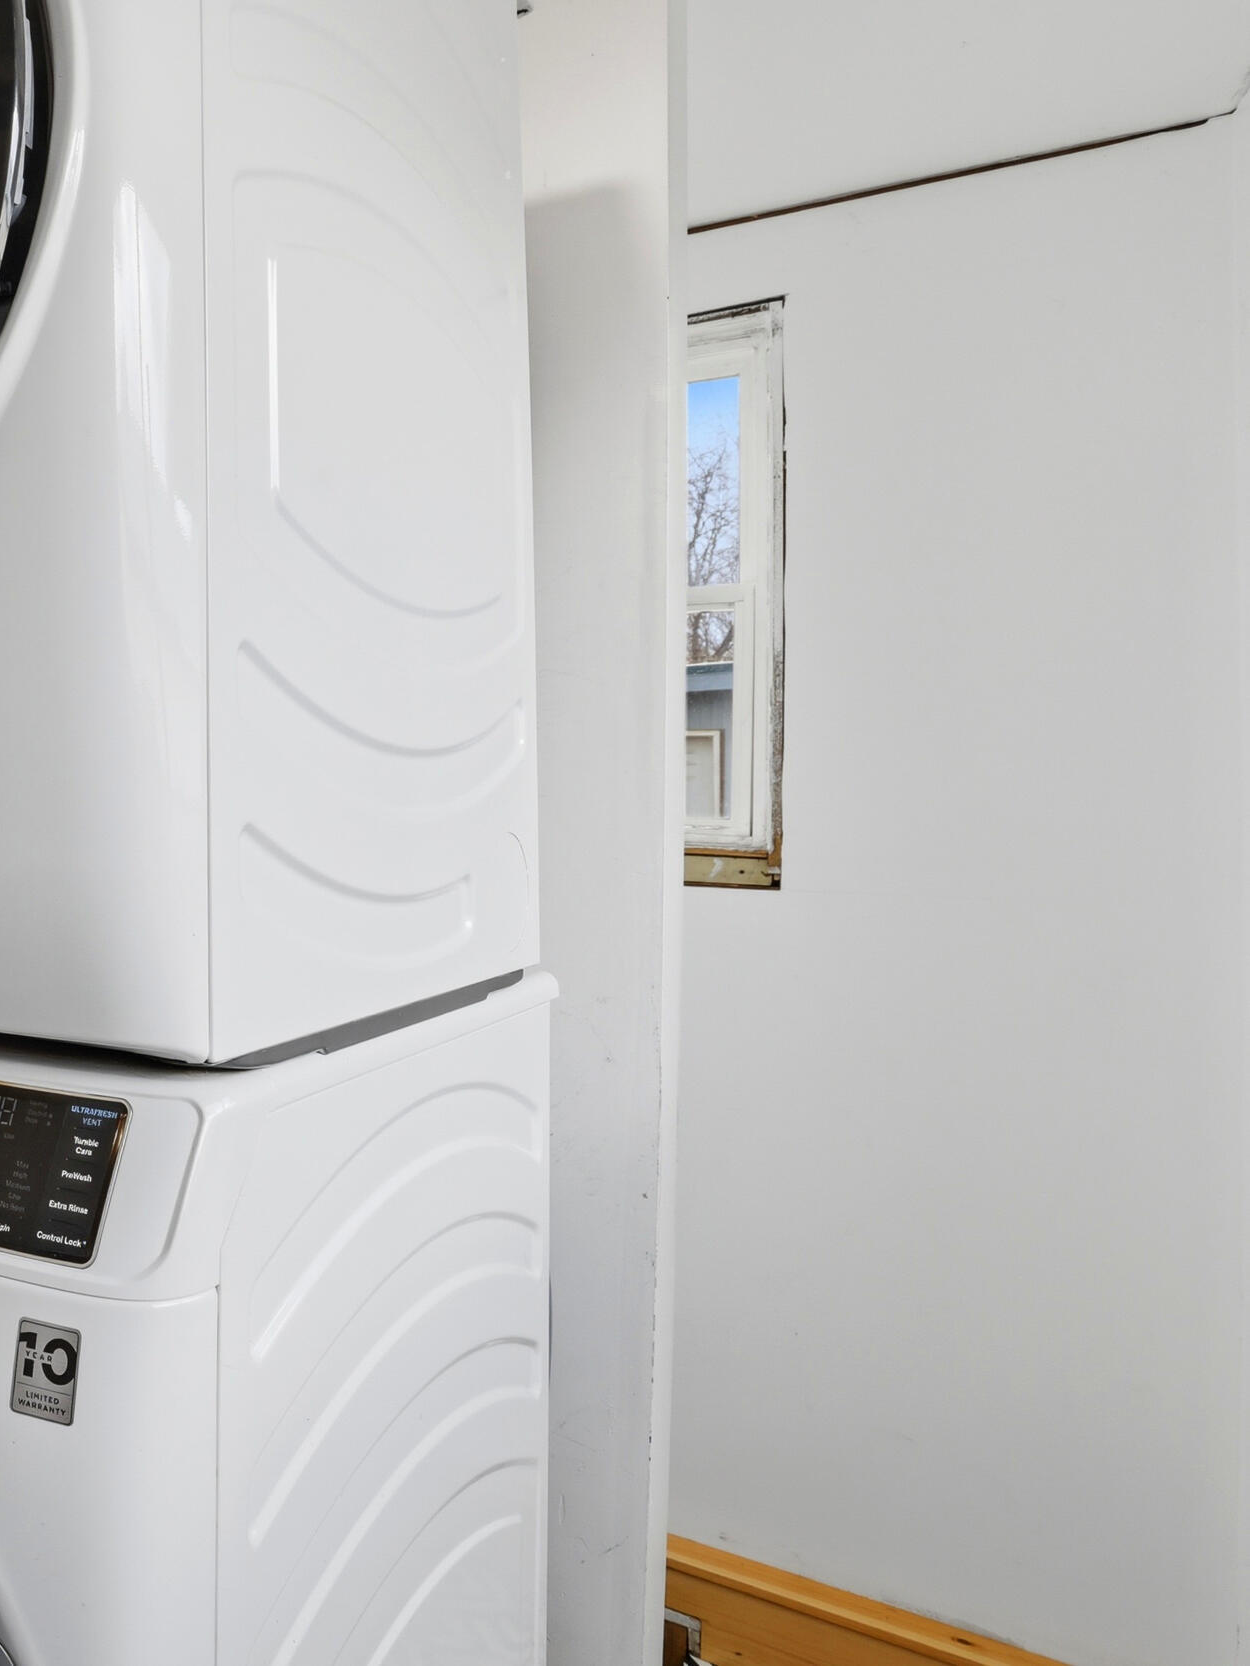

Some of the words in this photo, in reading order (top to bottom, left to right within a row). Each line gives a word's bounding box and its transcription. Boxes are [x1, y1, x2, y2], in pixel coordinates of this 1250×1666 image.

[71, 1104, 118, 1120] ULTRAFRESH
[81, 1117, 102, 1127] VENT
[73, 1135, 100, 1148] Tumble
[75, 1146, 93, 1156] Care
[61, 1169, 92, 1183] PreWash
[48, 1199, 68, 1211] Extra
[68, 1203, 89, 1215] Rinse
[36, 1230, 64, 1244] Control
[64, 1236, 82, 1248] Lock
[18, 1331, 78, 1386] 10
[25, 1350, 53, 1363] YEAR
[25, 1390, 60, 1405] LIMITED
[17, 1397, 67, 1416] WARRANTY
